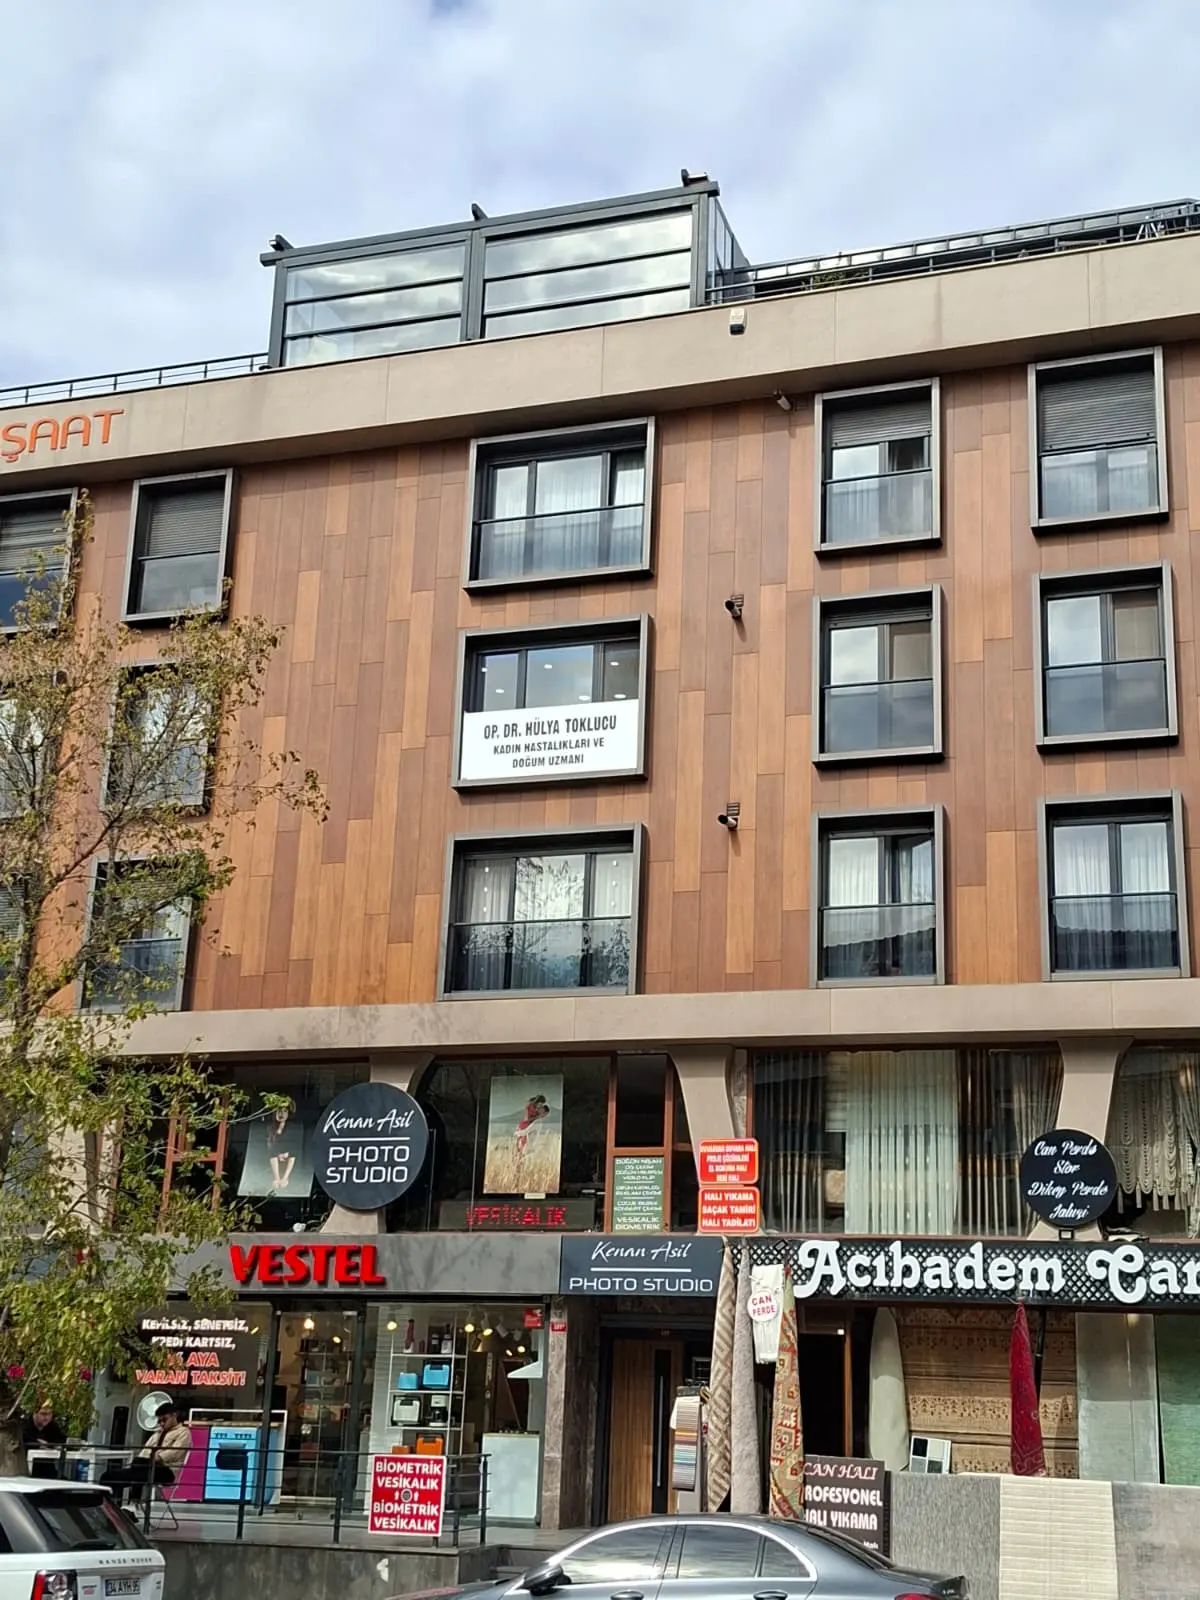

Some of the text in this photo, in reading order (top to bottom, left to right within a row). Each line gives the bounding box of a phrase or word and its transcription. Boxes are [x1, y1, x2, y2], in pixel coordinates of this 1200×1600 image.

[1, 409, 124, 463] ŞAAT
[484, 715, 617, 740] OP. DR. HÜLYA TOKLUCU
[493, 737, 605, 755] KADIN HASTALIKLARI VE
[512, 753, 584, 768] DOĞUM UZMANI
[323, 1108, 415, 1136] Kenan Asil
[328, 1145, 410, 1163] PHOTO
[1034, 1141, 1057, 1156] Can
[325, 1166, 408, 1184] STUDIO
[704, 1192, 754, 1201] HALI YIKAMA
[702, 1205, 728, 1216] SAÇAK
[702, 1218, 720, 1227] HALI
[591, 1241, 692, 1262] Kenan Asil
[230, 1244, 385, 1284] VESTEL
[793, 1239, 1065, 1298] Acıbadem
[569, 1277, 713, 1292] PHOTO STUDIO
[751, 1294, 772, 1306] CAN
[752, 1305, 776, 1317] PERDE
[185, 1336, 236, 1350] KARTSIZ,
[187, 1352, 220, 1368] AYA
[135, 1367, 246, 1385] VARAN TAKSİT!
[375, 1458, 442, 1475] BİOMETRİK
[803, 1462, 878, 1480] CAN HALI
[377, 1474, 439, 1490] VESİKALIK
[804, 1485, 883, 1507] ROFESYONEL
[373, 1499, 439, 1516] BİOMETRİK
[374, 1515, 436, 1531] VESİKALIK
[830, 1510, 878, 1531] YIKAMA
